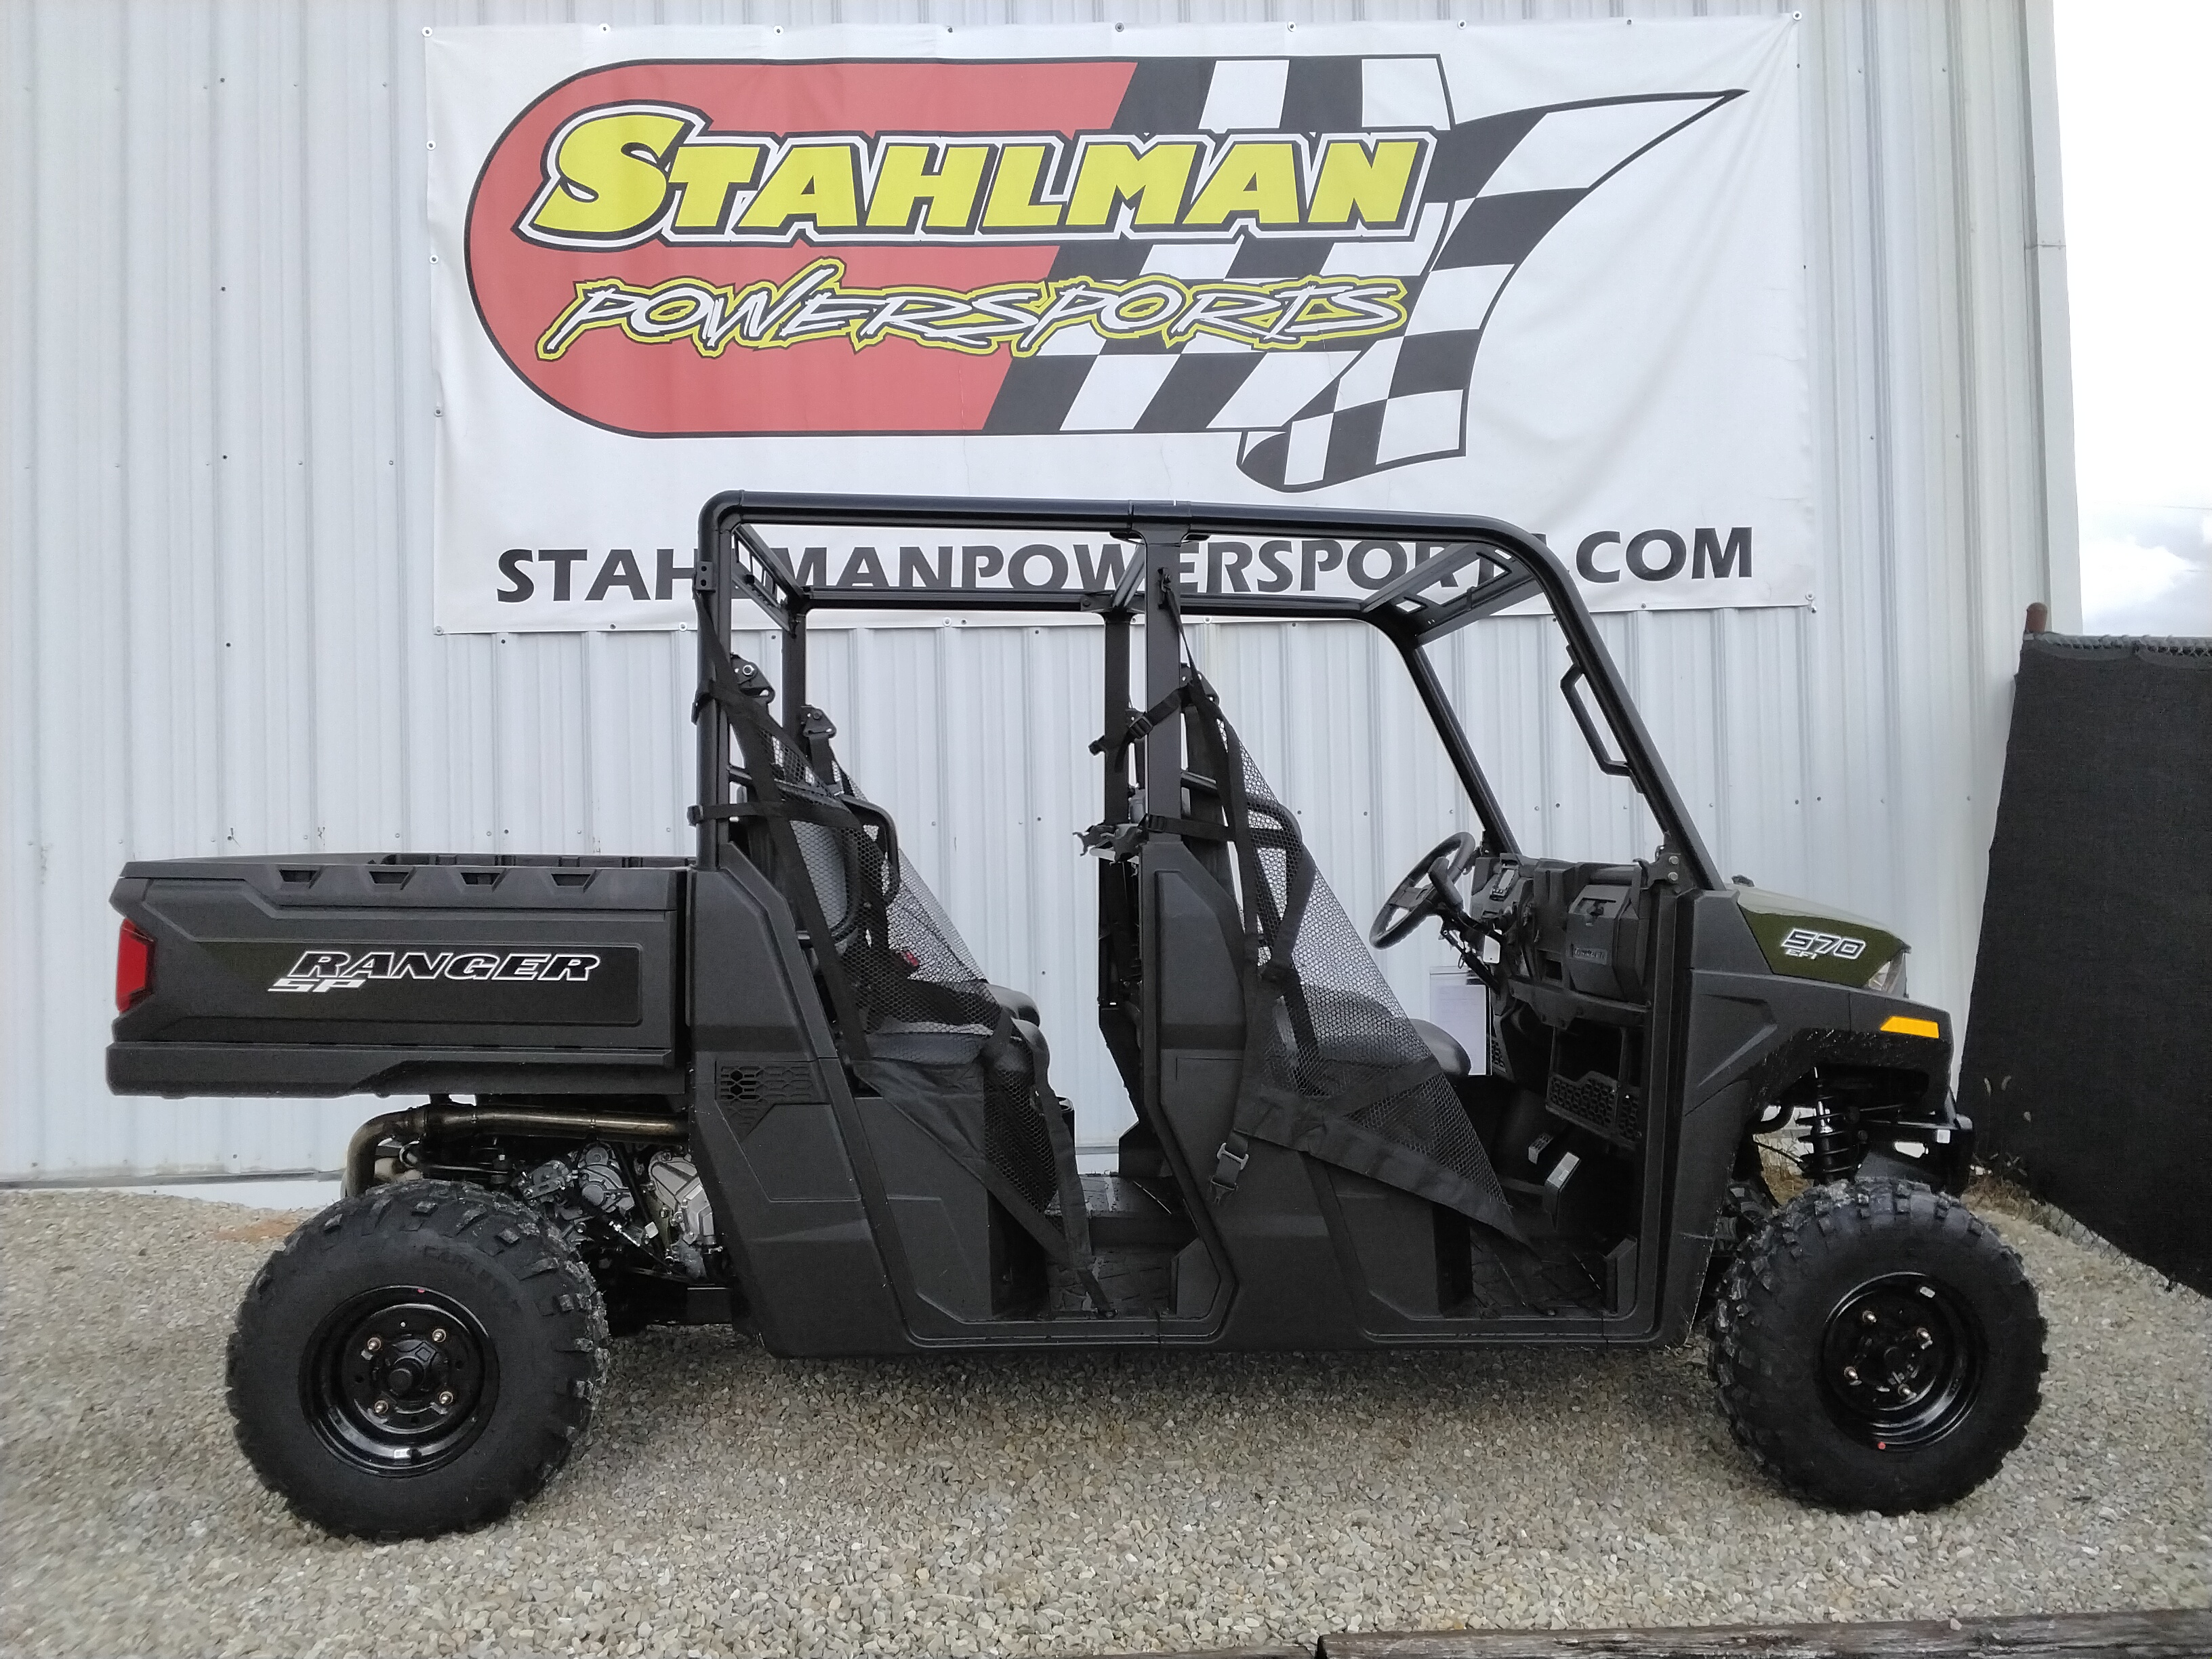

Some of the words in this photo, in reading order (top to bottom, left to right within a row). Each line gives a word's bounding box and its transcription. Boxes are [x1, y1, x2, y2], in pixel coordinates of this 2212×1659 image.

[517, 104, 1437, 247] STAHLMAN
[538, 258, 1408, 360] POWERSPORTS
[496, 526, 1753, 603] STAHMANPOWERSPOCOM
[1782, 928, 1866, 960] 570
[1785, 949, 1818, 960] EFI
[287, 950, 601, 981] RANGER
[268, 977, 367, 993] SP
